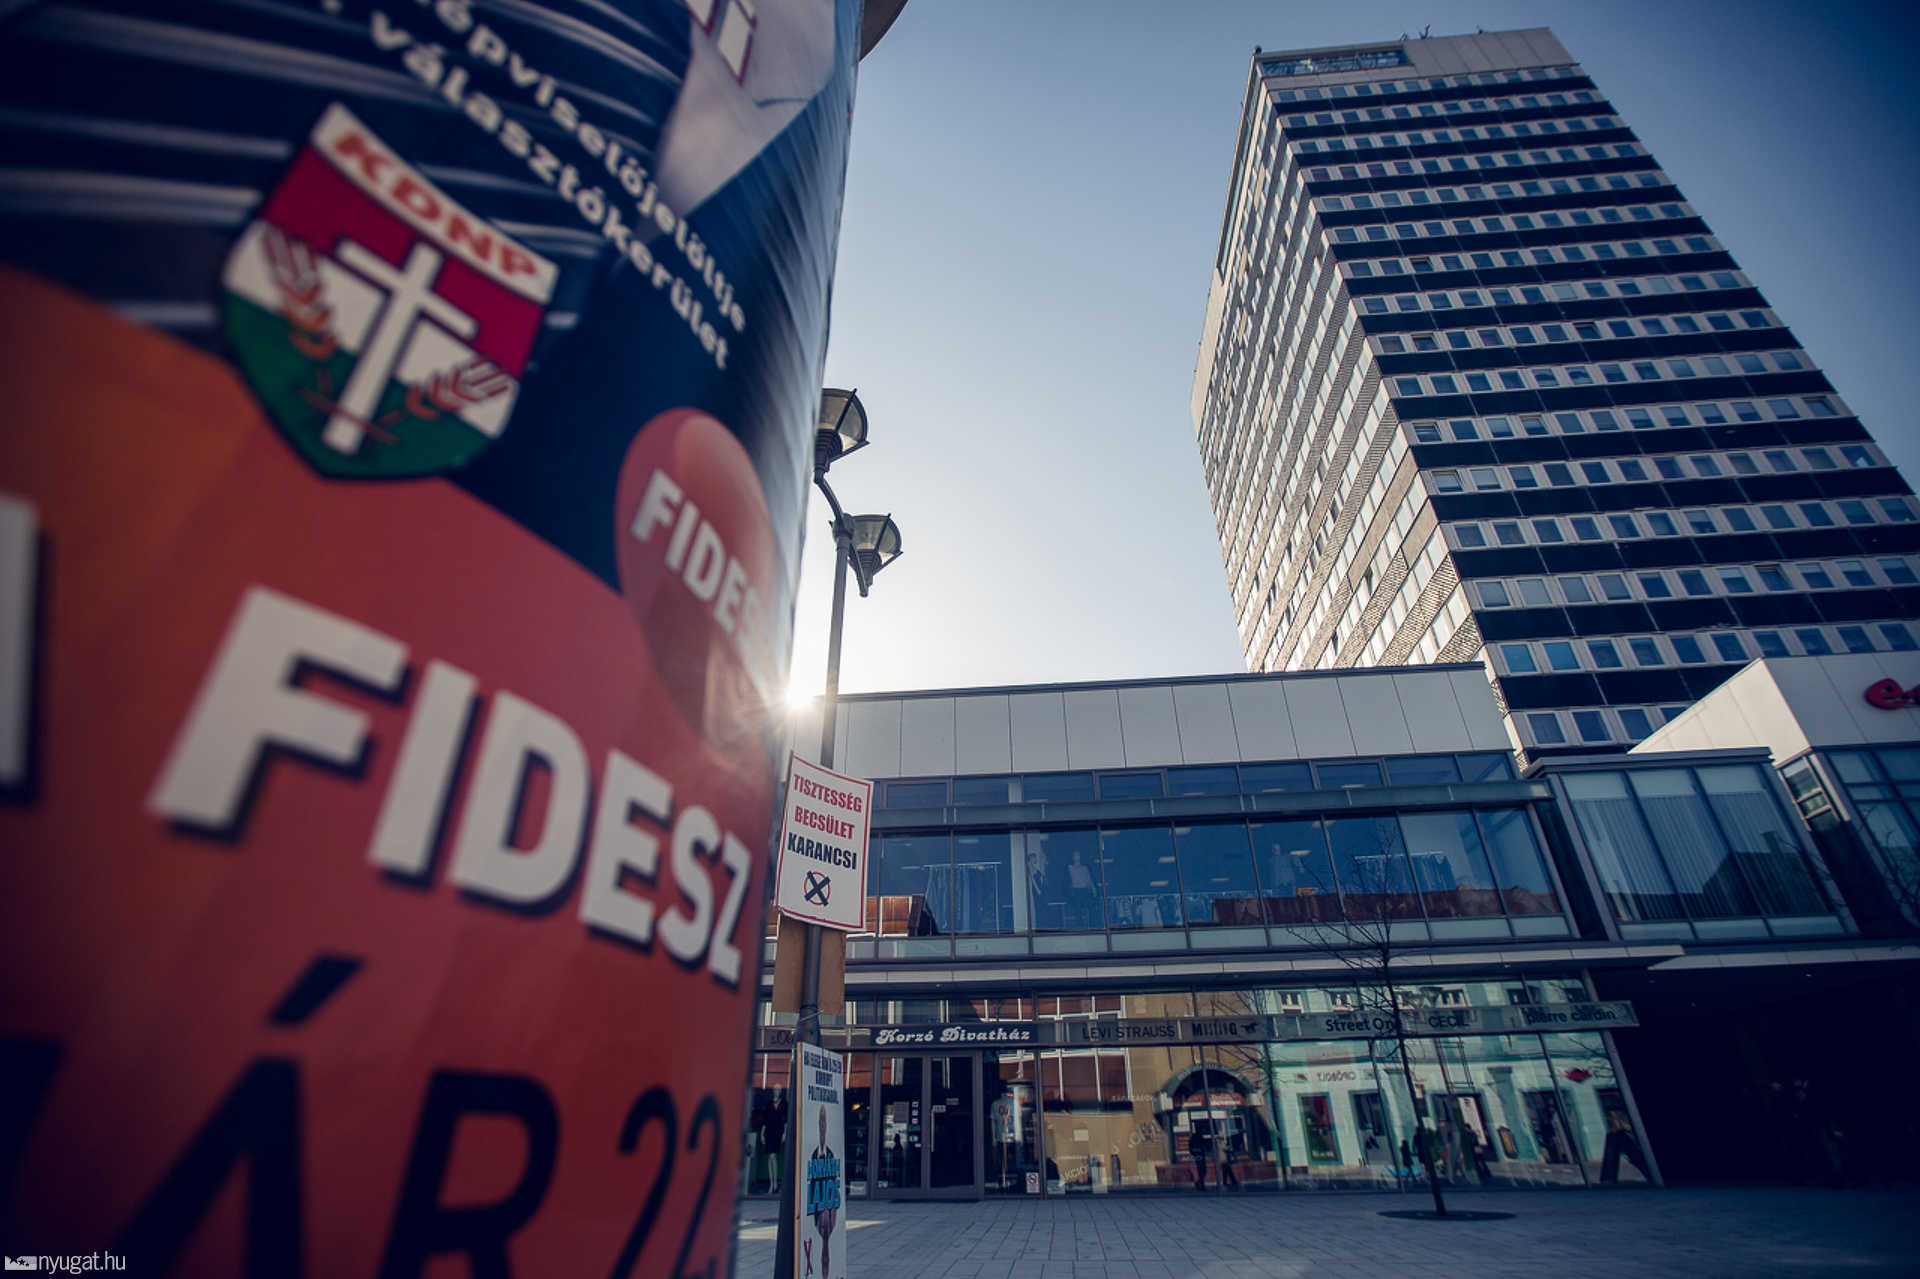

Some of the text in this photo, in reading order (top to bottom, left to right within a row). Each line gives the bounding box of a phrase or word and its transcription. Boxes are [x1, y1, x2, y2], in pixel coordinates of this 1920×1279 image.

[332, 128, 538, 277] KDNP
[147, 584, 752, 986] FIDESZ
[793, 773, 863, 813] TISZTESSÉG
[794, 805, 855, 840] BECSÜLET
[787, 831, 857, 870] KARANCSI
[1082, 1026, 1112, 1039] LEVI
[1116, 1024, 1176, 1039] STRAUSS
[1325, 1018, 1370, 1032] Street
[1428, 1015, 1470, 1029] CECIL
[1526, 1008, 1617, 1025] pierre cardin
[875, 1026, 1031, 1044] Korzó Divatház
[807, 1179, 841, 1215] LAJOS
